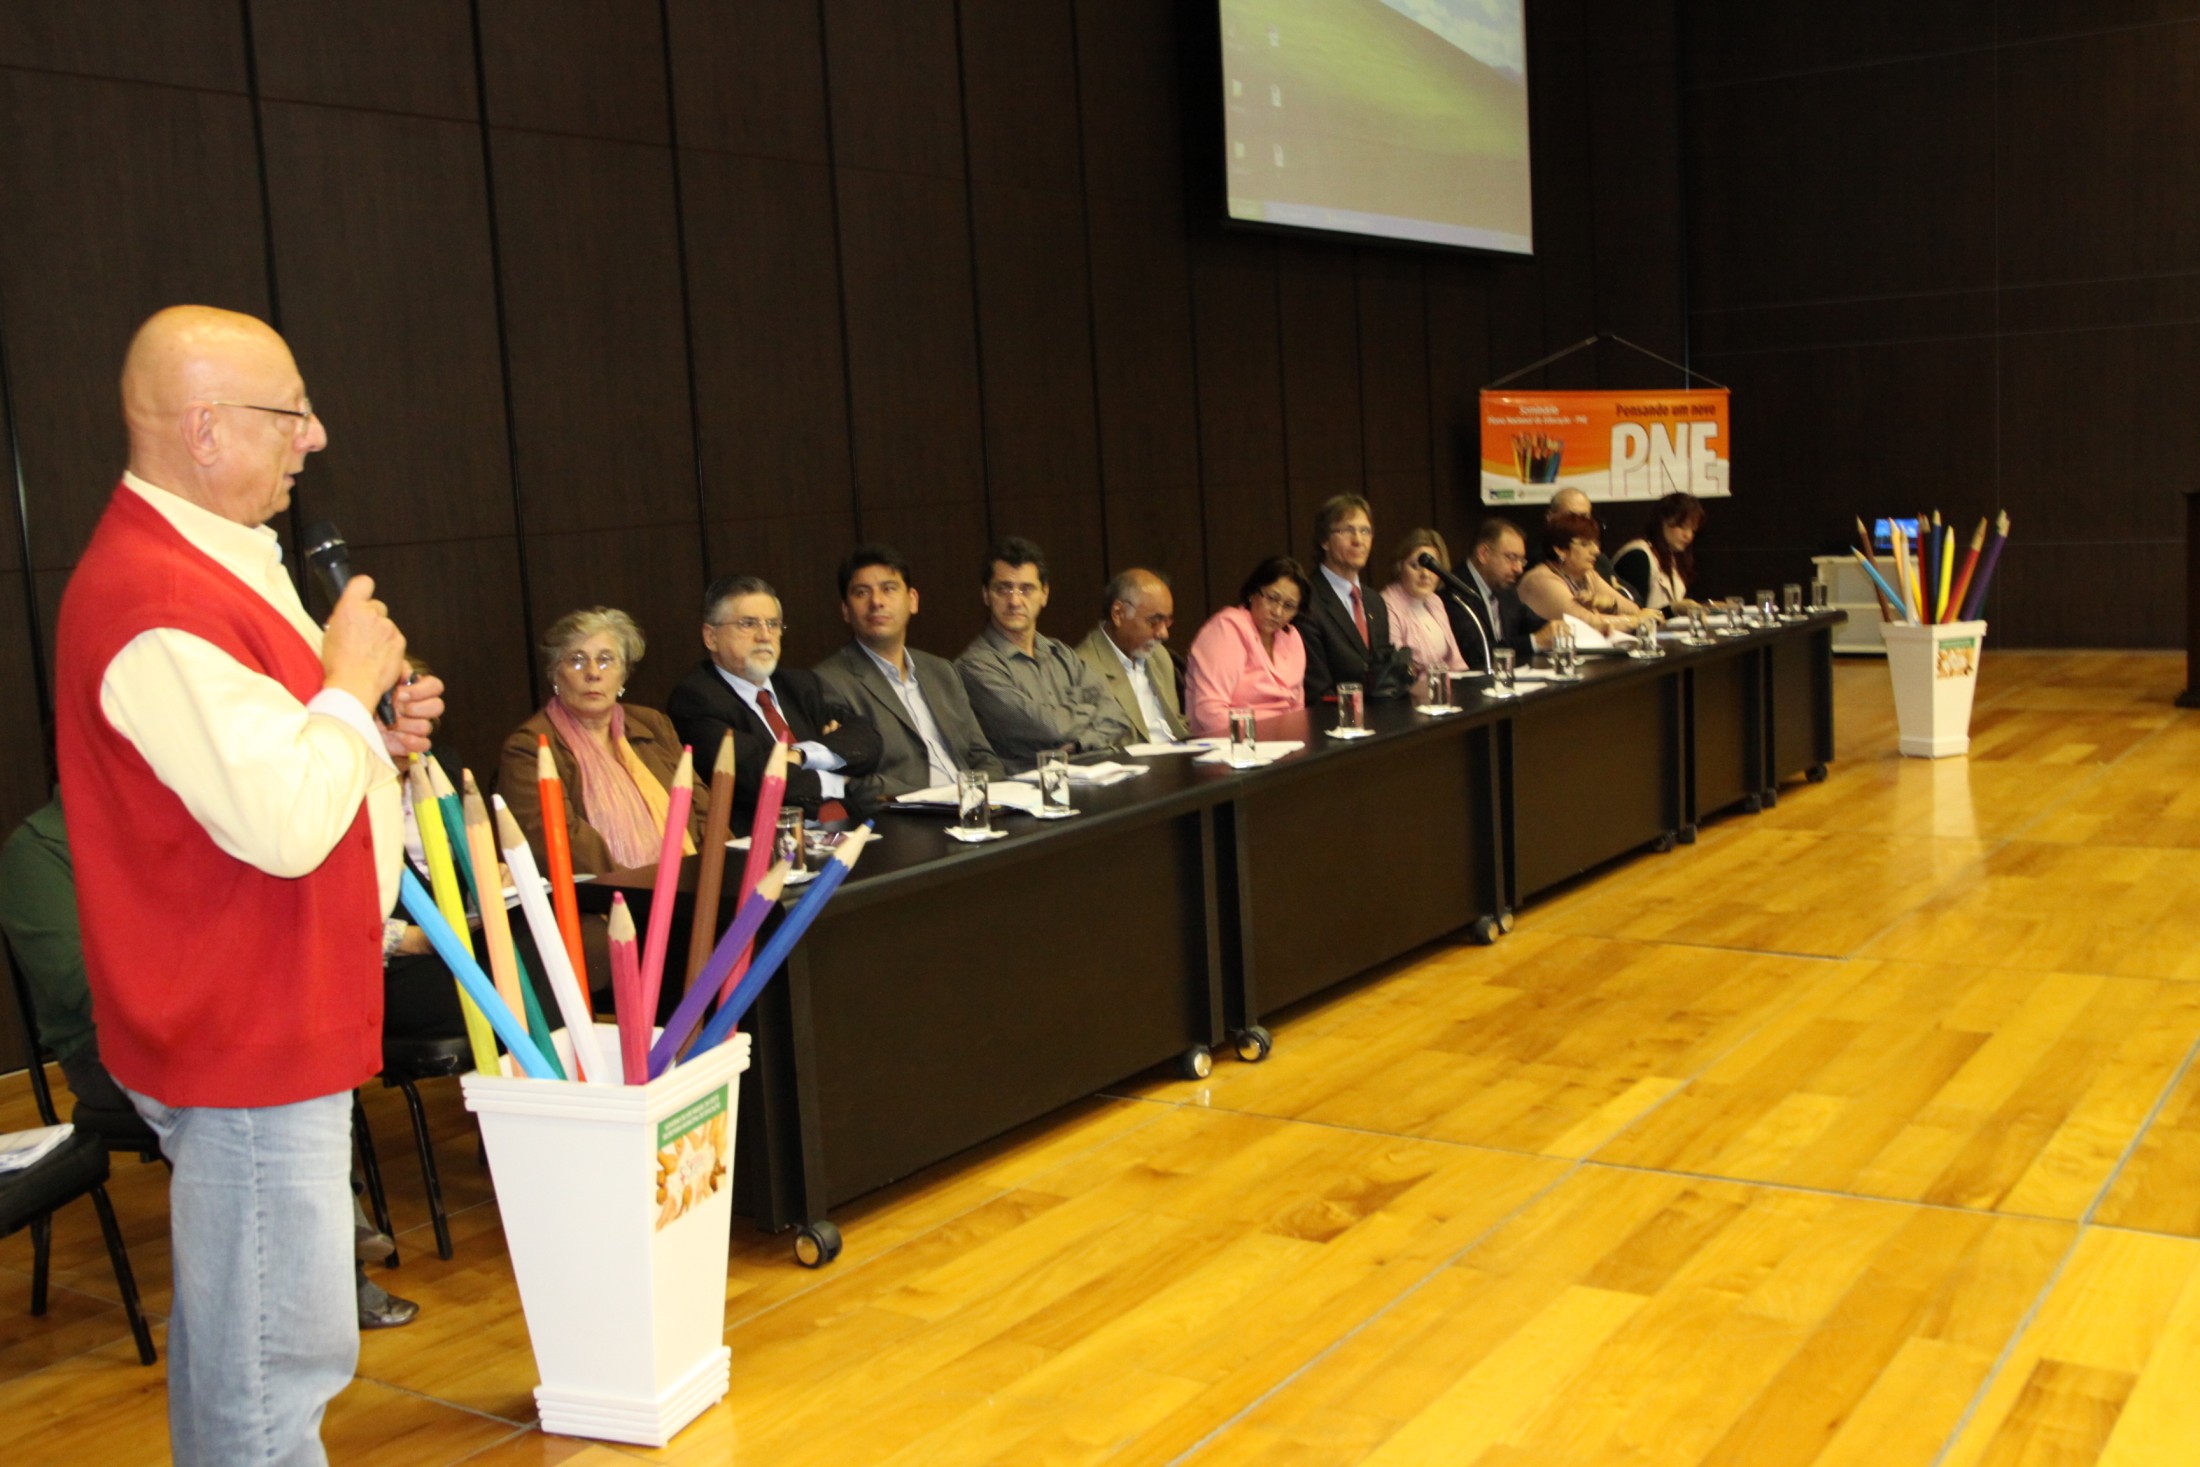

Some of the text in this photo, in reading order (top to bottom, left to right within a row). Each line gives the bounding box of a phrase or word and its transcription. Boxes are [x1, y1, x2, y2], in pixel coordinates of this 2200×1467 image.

[1616, 403, 1716, 417] Pensando um novo
[1610, 421, 1718, 498] PNE
